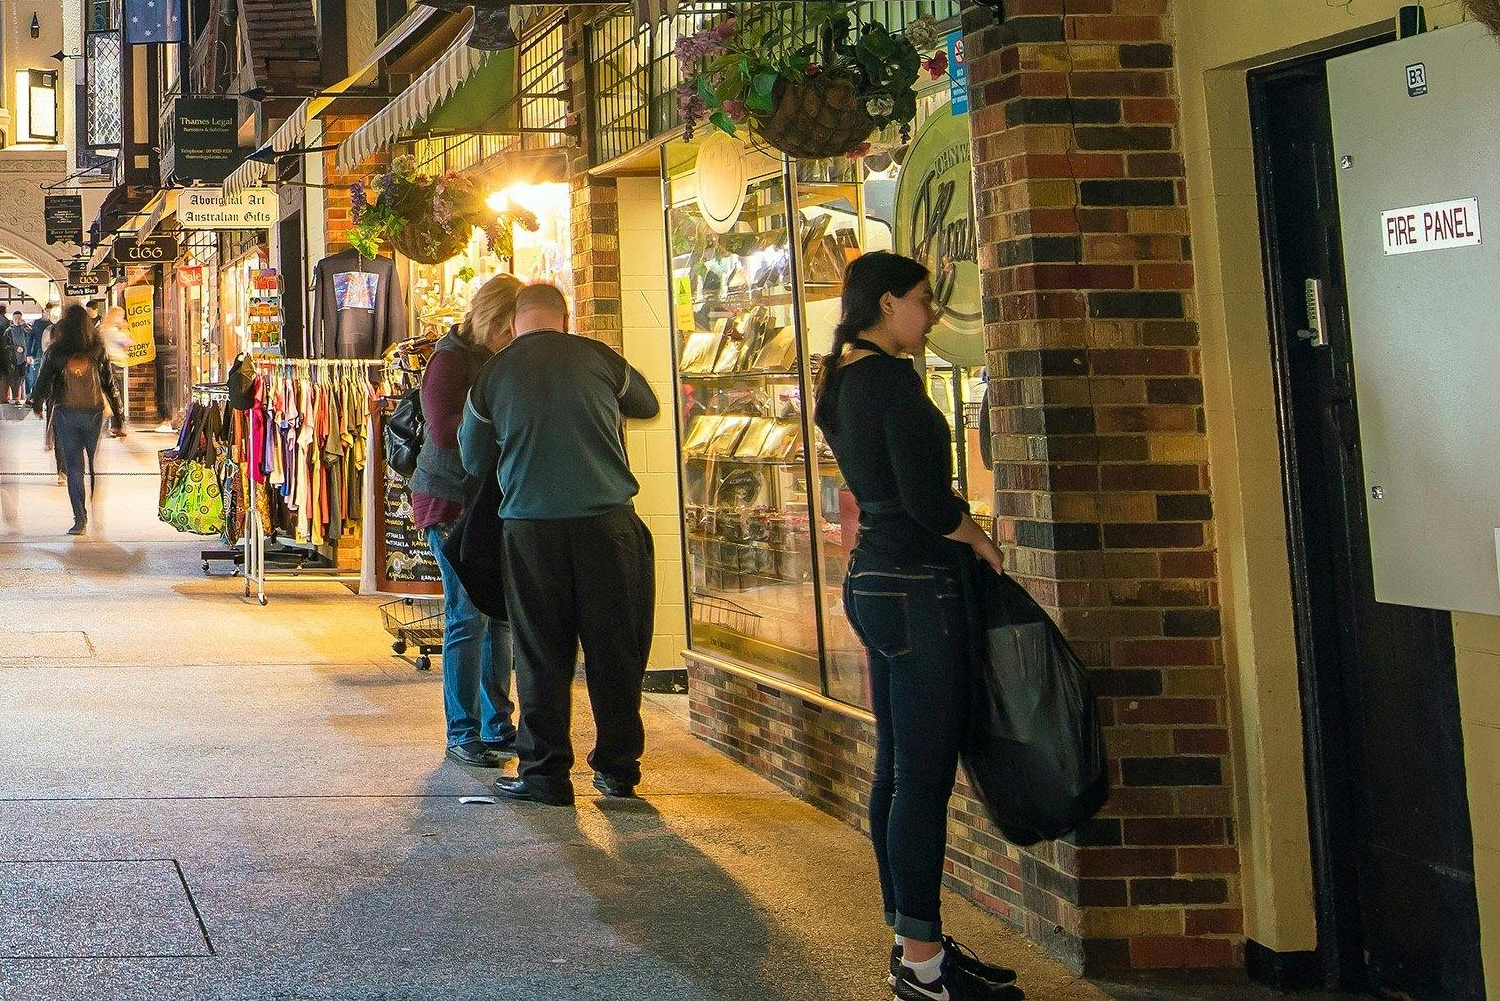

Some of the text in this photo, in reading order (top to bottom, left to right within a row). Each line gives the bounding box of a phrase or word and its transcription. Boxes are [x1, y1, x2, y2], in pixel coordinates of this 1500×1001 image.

[180, 117, 233, 128] Thames Legal
[248, 194, 265, 205] Art
[185, 210, 271, 223] Australian Gifts
[1387, 206, 1475, 247] FIRE PANEL
[129, 247, 163, 259] UGG
[128, 305, 151, 316] UGG
[131, 319, 151, 328] BOOTS
[128, 342, 150, 352] CTORY
